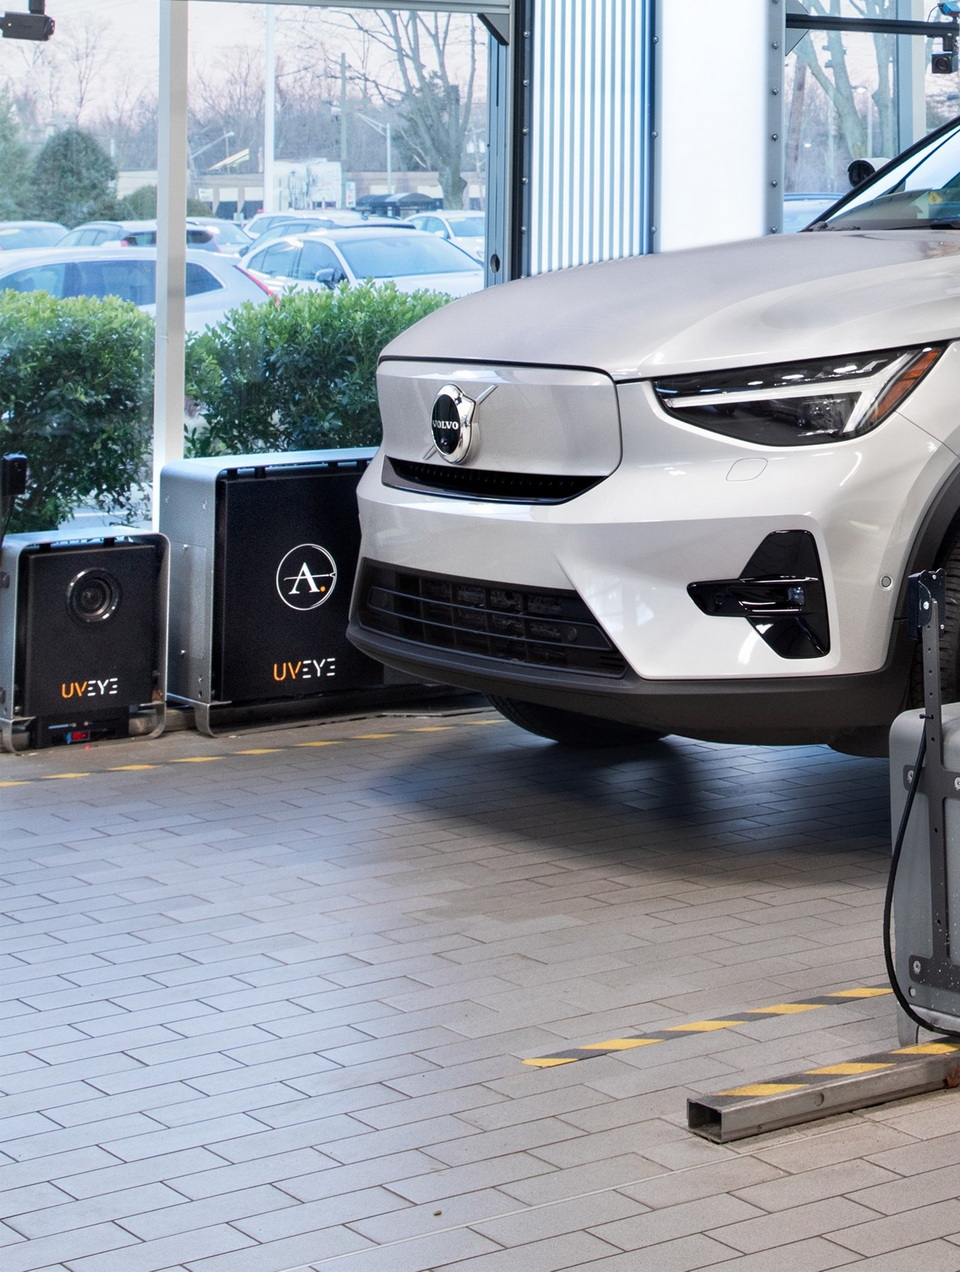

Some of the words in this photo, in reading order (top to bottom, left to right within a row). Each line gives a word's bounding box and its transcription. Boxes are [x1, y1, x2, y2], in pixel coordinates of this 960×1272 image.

[432, 419, 460, 430] VOLVO
[273, 658, 336, 681] UVEYE
[61, 678, 118, 699] UVEYE
